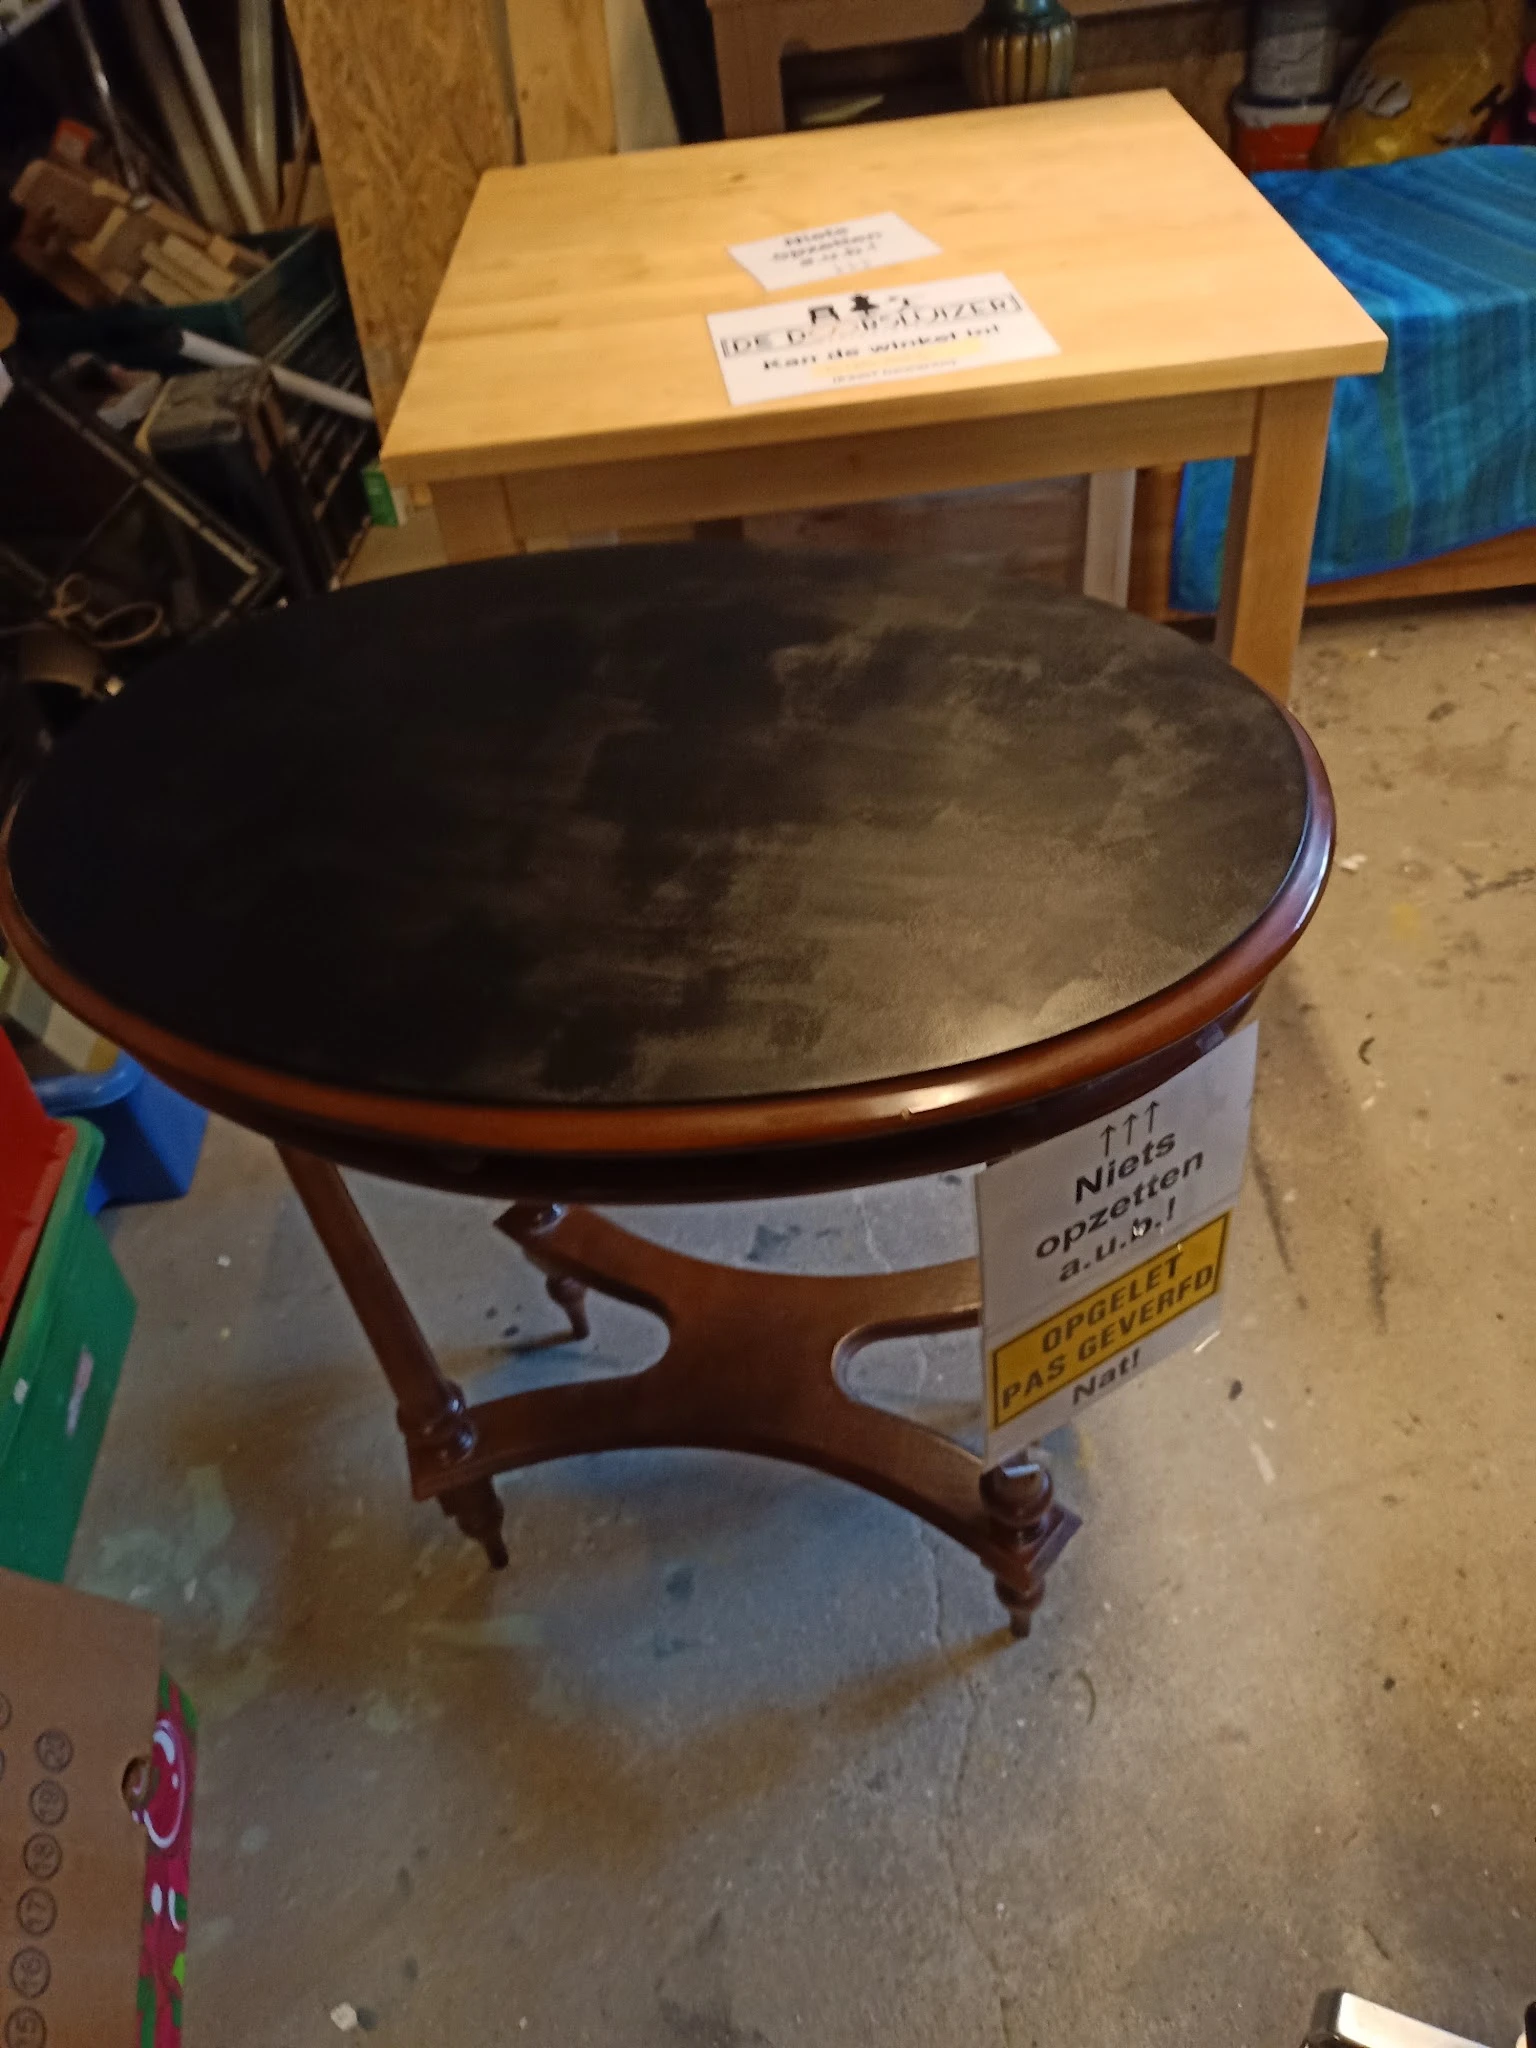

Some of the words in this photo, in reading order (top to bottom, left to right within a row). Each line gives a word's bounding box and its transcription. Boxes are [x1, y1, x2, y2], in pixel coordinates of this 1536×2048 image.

[764, 355, 817, 370] Kan
[870, 332, 956, 353] winkel
[1036, 1152, 1204, 1260] opzetten
[1075, 1132, 1176, 1204] Niets
[1001, 1354, 1066, 1410] PAS
[1078, 1264, 1214, 1365] GEVERFD
[1042, 1253, 1184, 1354] OPGELET
[1072, 1347, 1140, 1406] Nat!
